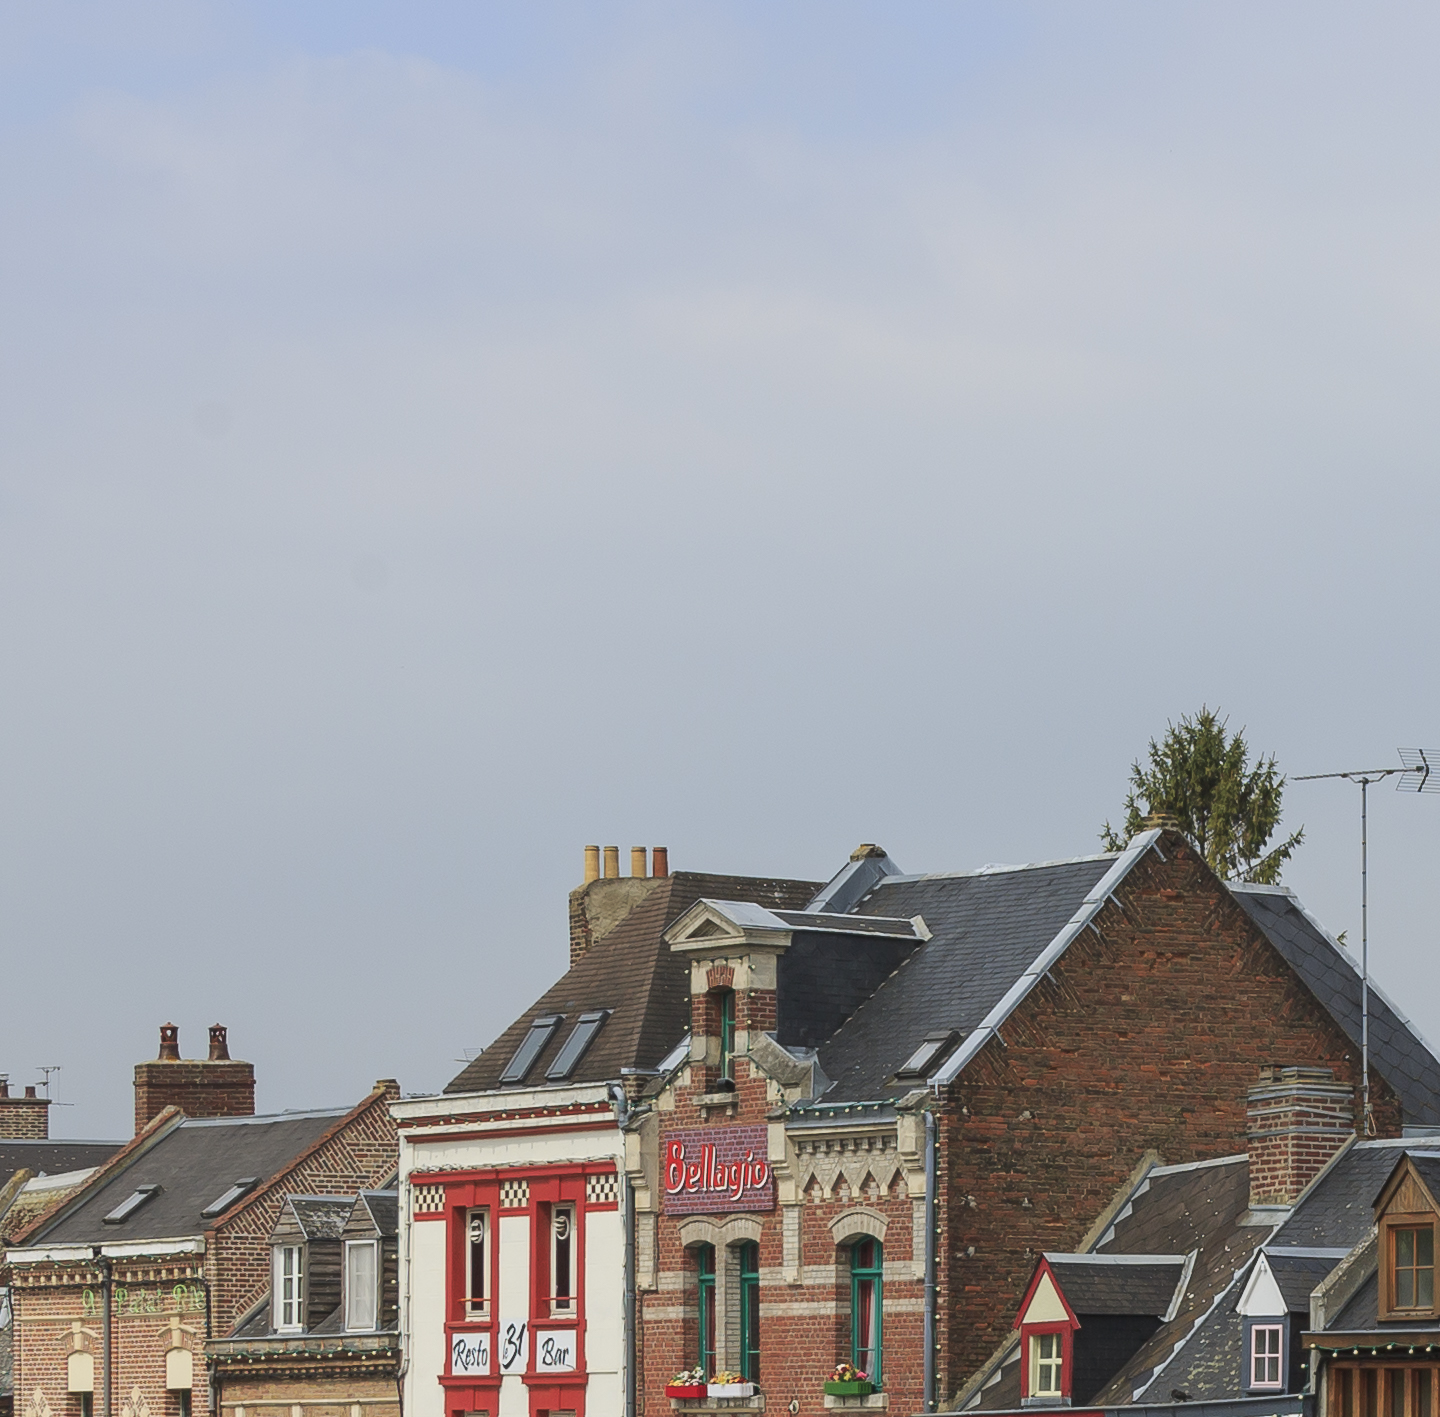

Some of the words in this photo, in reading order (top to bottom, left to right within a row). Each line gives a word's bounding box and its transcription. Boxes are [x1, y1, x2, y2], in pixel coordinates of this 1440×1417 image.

[664, 1139, 769, 1201] Bellagio
[453, 1338, 488, 1371] Resto
[502, 1322, 526, 1370] 31
[542, 1337, 572, 1367] Bar
